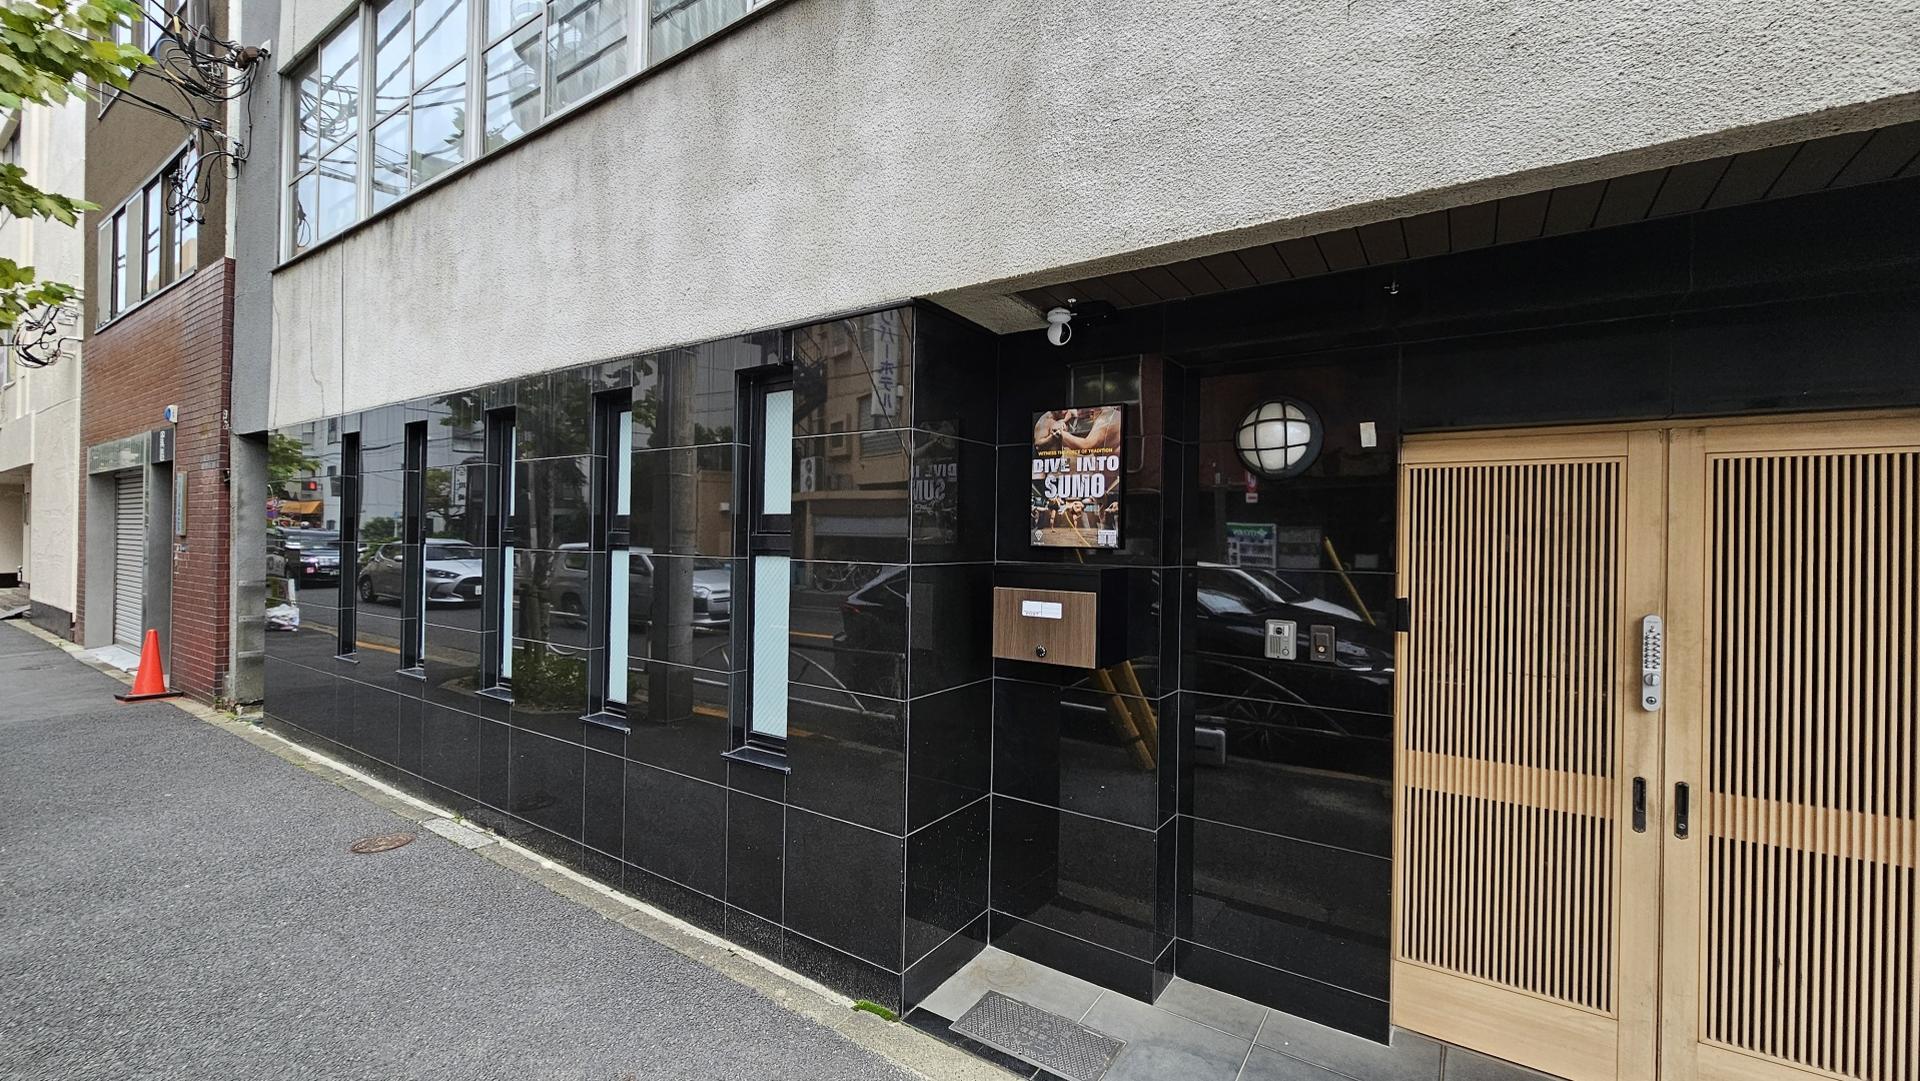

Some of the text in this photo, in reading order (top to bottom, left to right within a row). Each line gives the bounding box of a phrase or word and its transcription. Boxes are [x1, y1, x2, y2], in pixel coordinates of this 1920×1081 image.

[1032, 455, 1119, 473] DIVE INTO
[1044, 473, 1105, 498] SUMO
